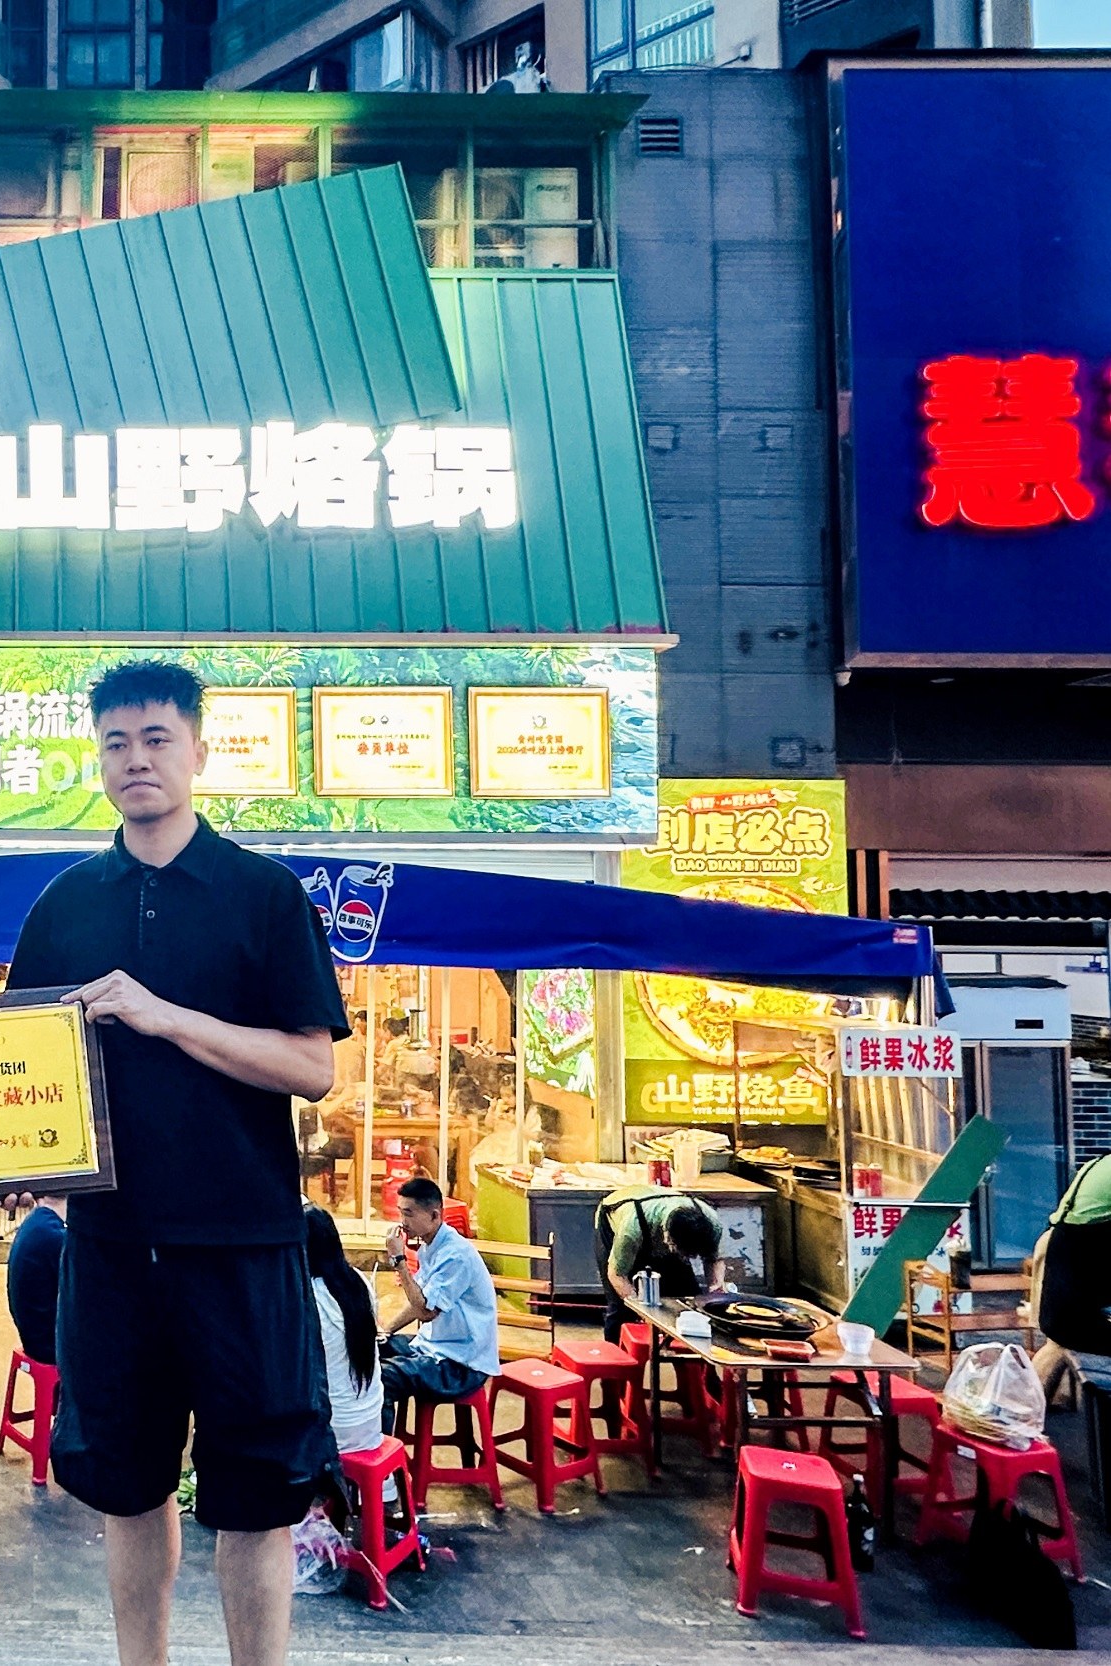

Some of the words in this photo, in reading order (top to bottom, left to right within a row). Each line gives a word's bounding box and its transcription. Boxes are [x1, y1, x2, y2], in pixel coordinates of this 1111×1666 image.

[921, 354, 1111, 528] 慧
[646, 810, 831, 855] 到店必点
[675, 858, 706, 872] DAO
[707, 859, 742, 872] DIAN
[761, 860, 797, 872] DIAN
[339, 913, 372, 930] 百事可乐
[859, 1035, 955, 1072] 鲜果冰浆
[655, 1072, 819, 1106] 山野烧鱼
